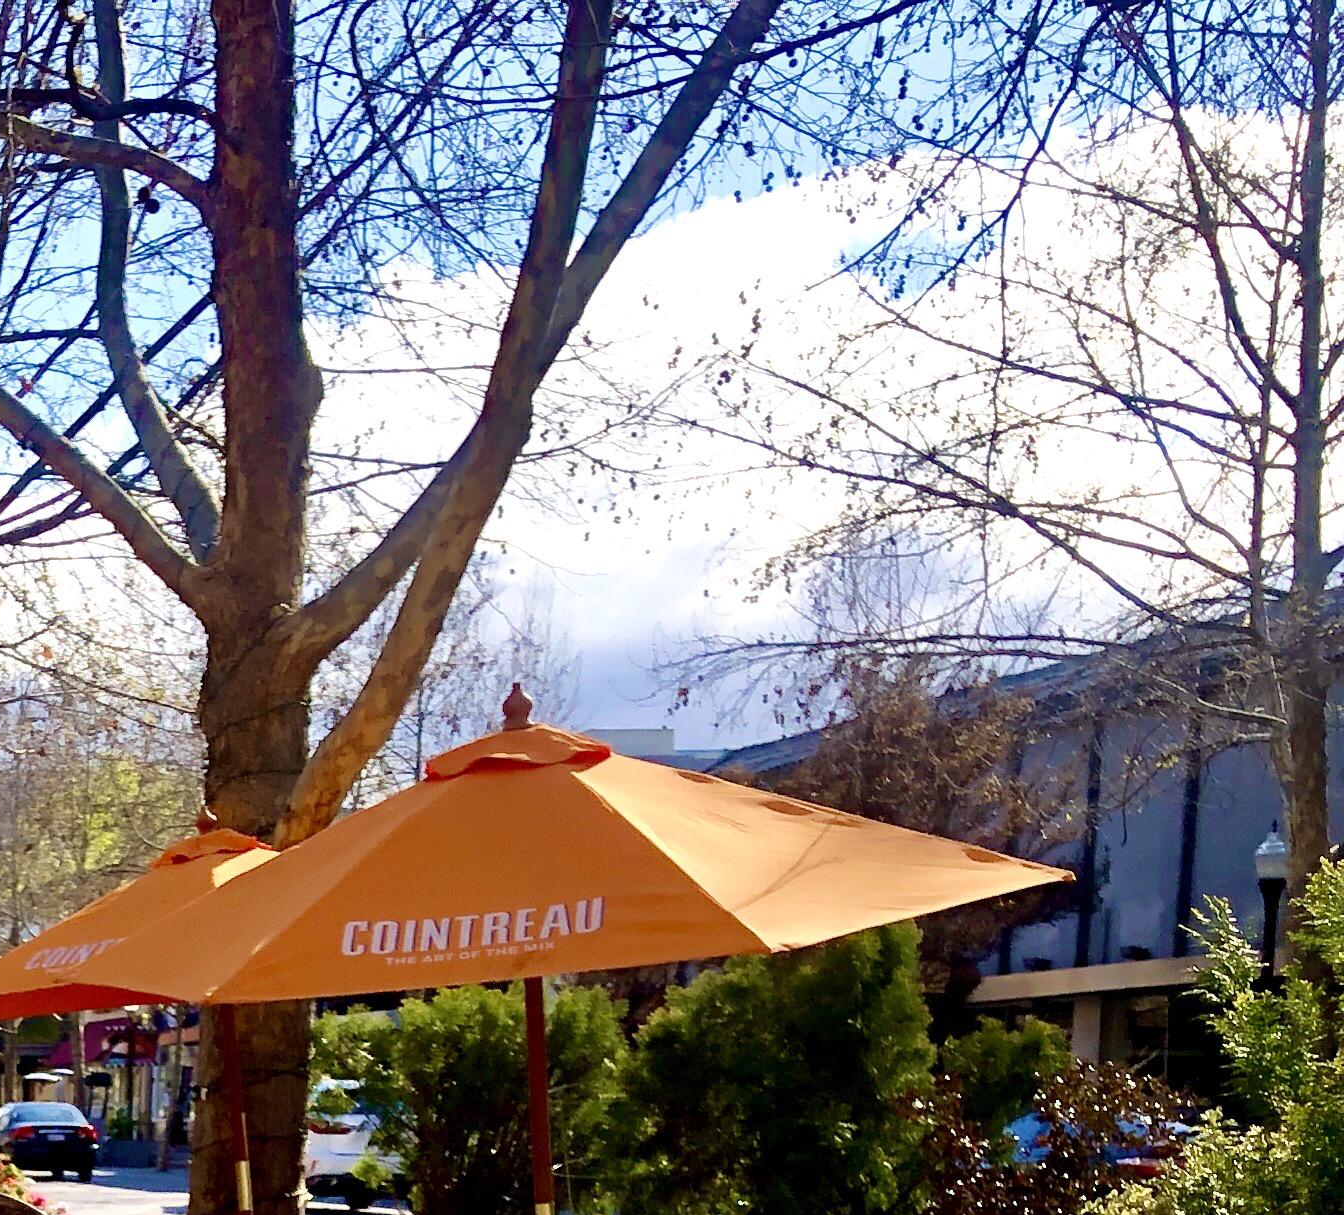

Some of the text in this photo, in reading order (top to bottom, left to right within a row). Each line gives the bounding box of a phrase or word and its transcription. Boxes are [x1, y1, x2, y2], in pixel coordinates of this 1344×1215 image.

[341, 896, 605, 956] COINTREAU
[385, 940, 555, 966] THE ART OF THE MIX
